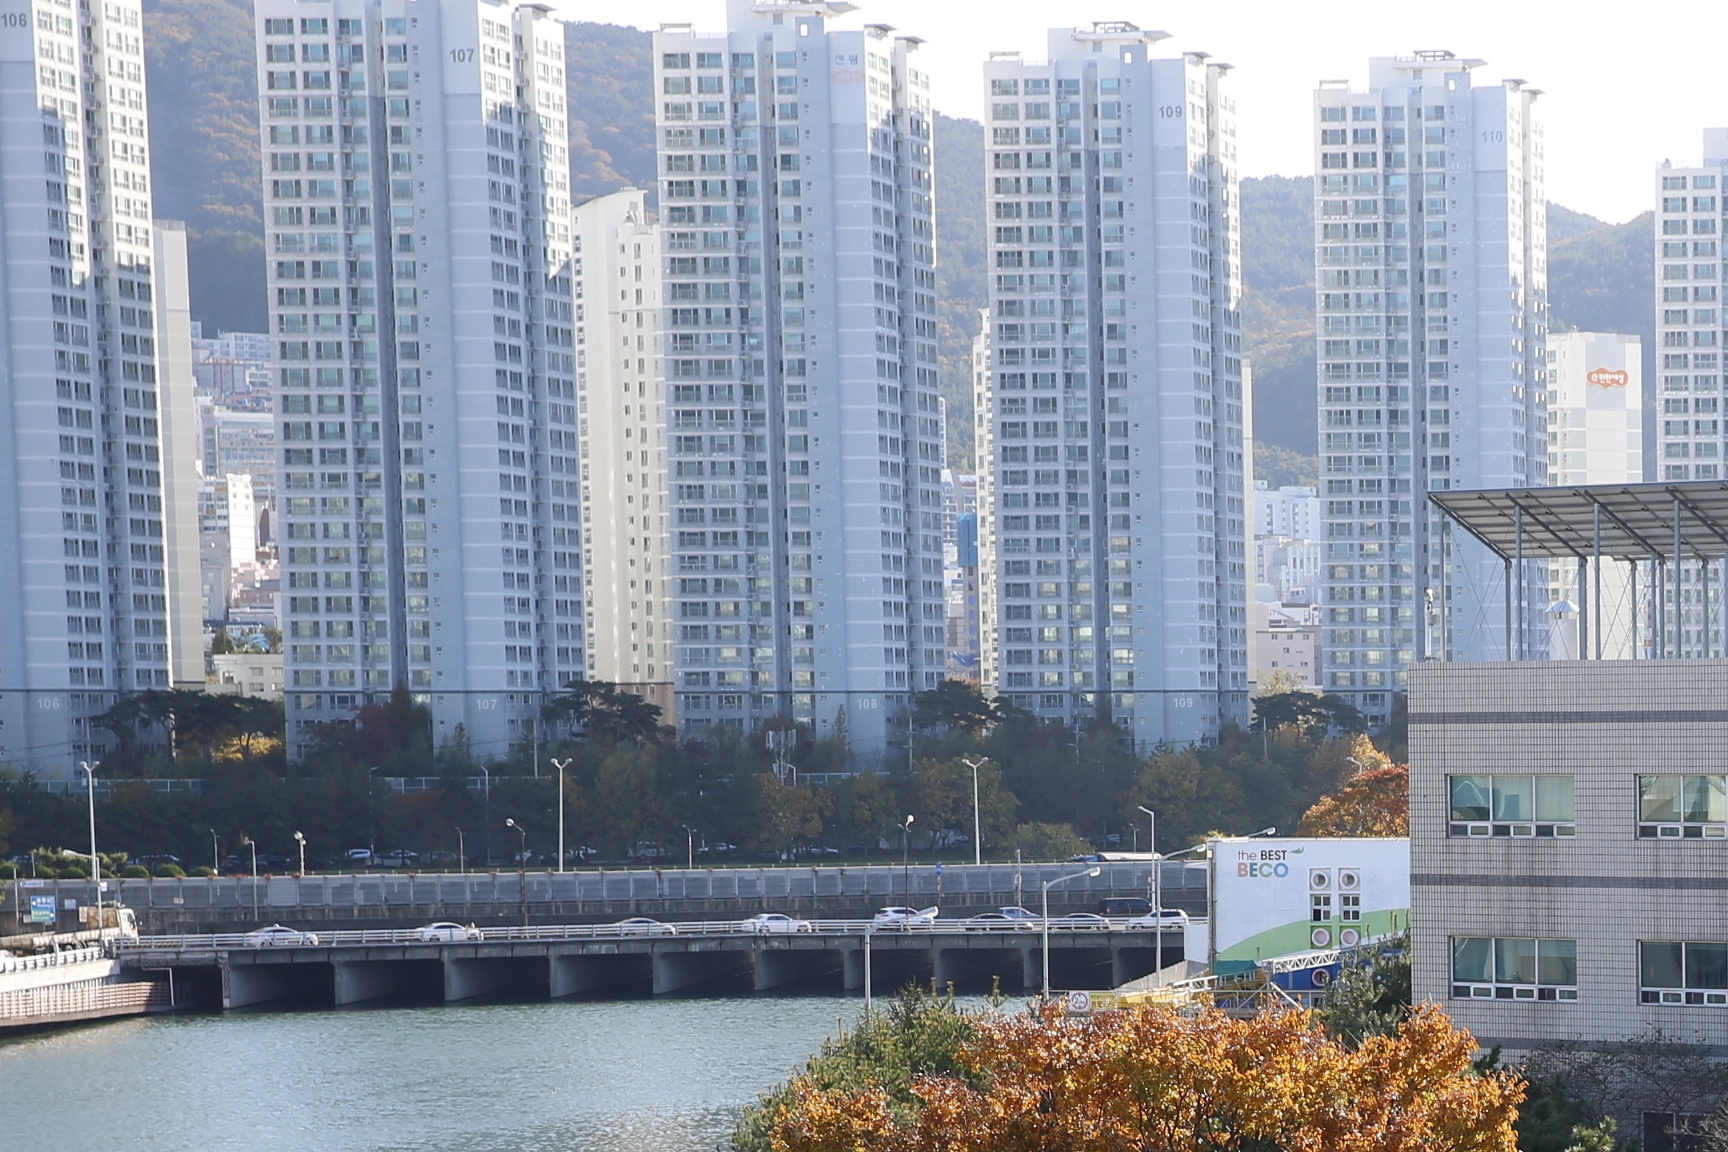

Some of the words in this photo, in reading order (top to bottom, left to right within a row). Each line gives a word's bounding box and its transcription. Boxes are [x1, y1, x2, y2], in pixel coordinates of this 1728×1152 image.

[1, 13, 27, 28] 106
[450, 49, 475, 63] 107
[1159, 105, 1182, 118] 109
[1481, 131, 1503, 143] 110
[37, 698, 60, 710] 106
[476, 699, 497, 710] 107
[857, 699, 878, 709] 108
[1173, 698, 1193, 708] 109
[1237, 850, 1257, 861] the
[1260, 850, 1288, 861] BEST
[1237, 862, 1289, 878] BECO
